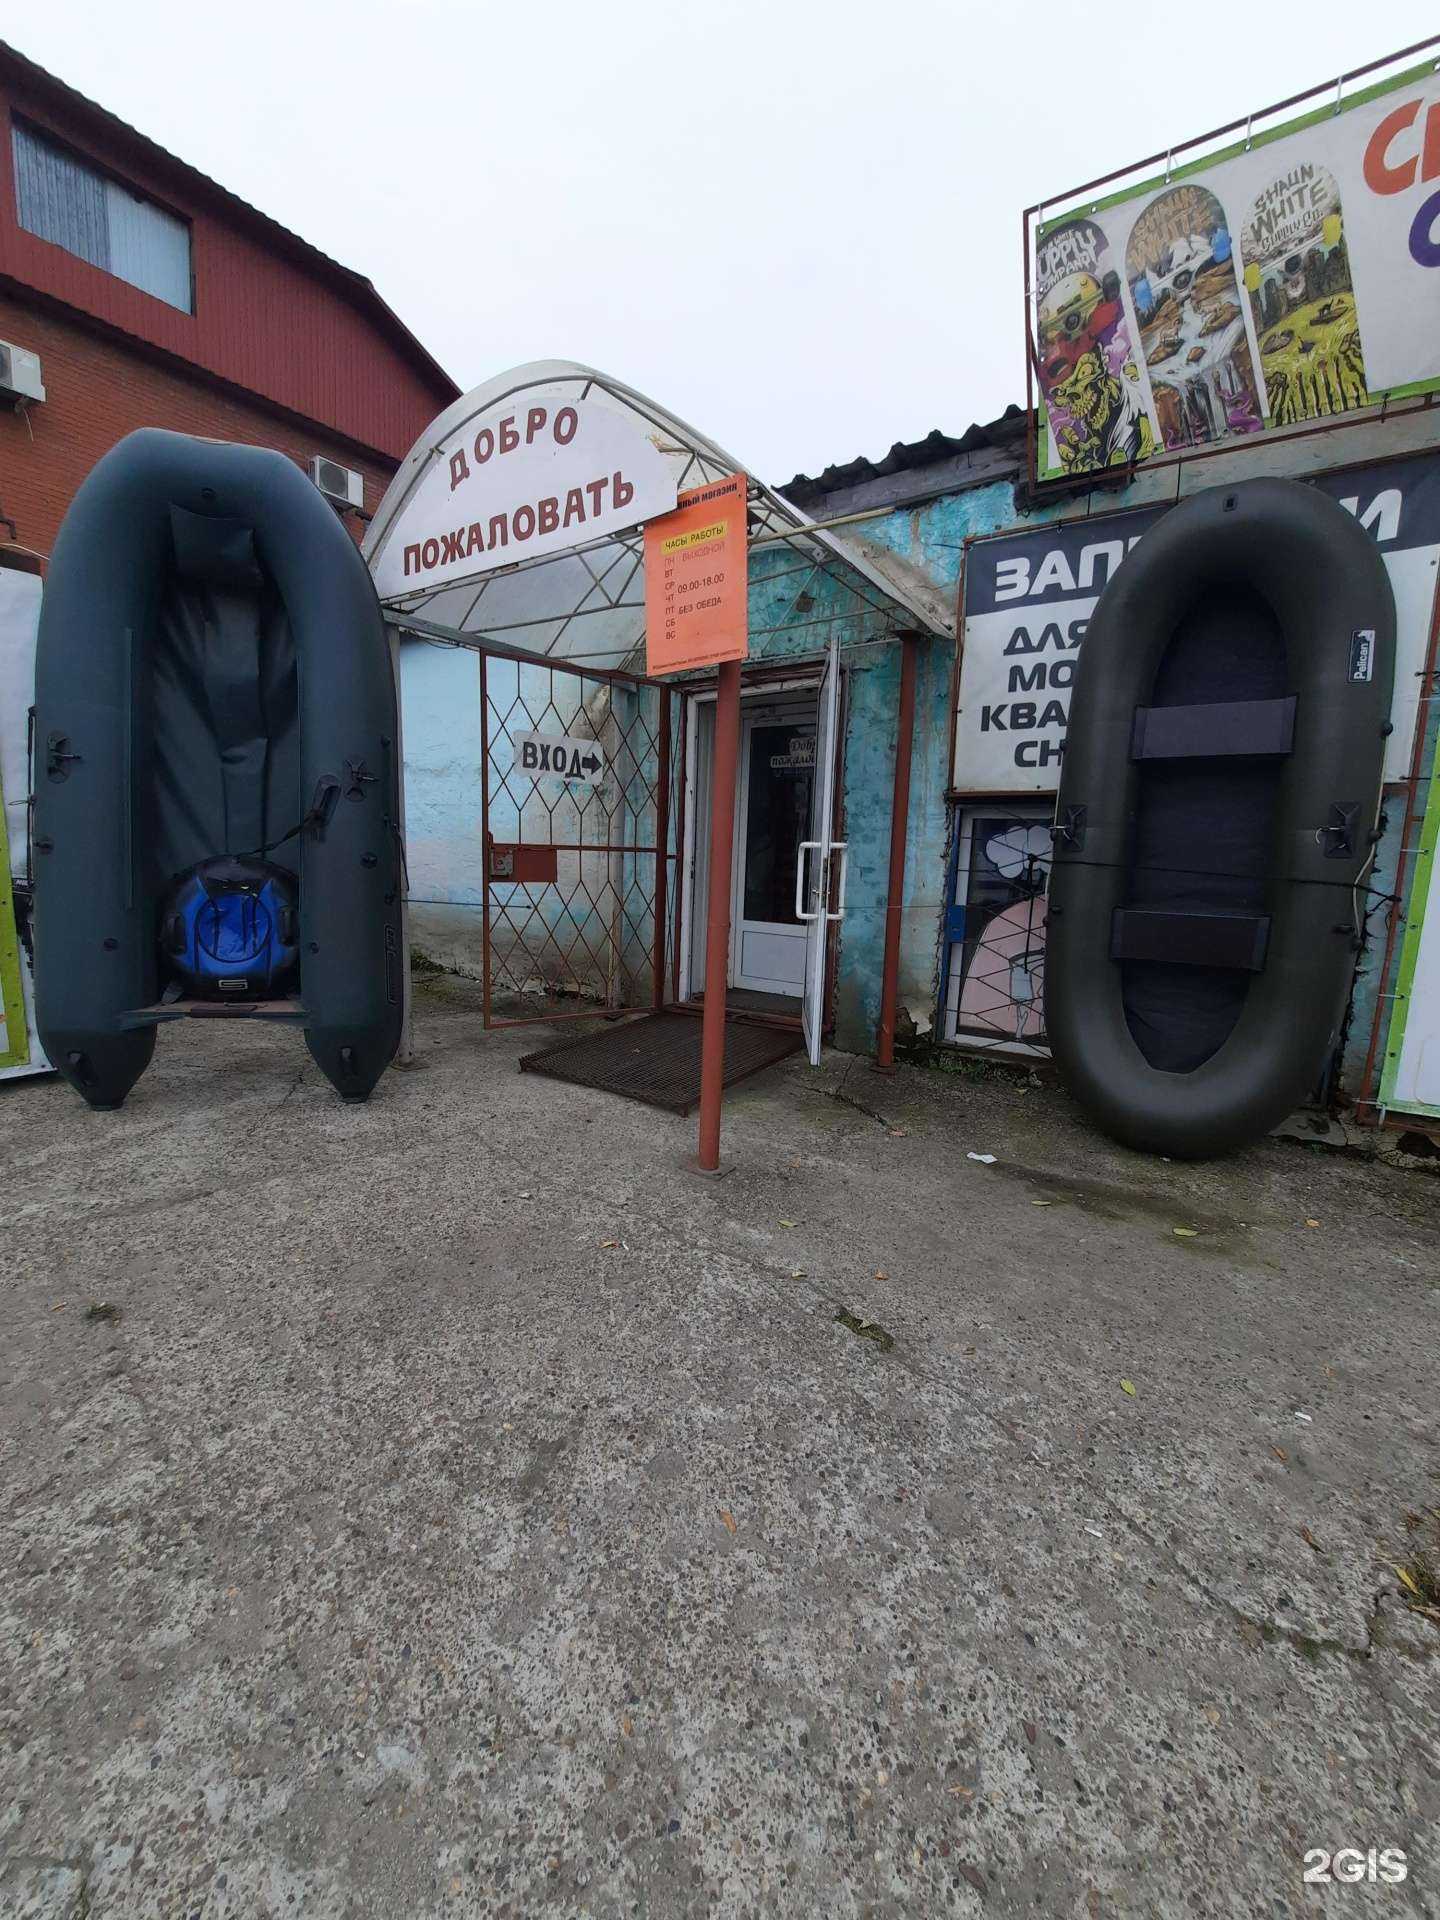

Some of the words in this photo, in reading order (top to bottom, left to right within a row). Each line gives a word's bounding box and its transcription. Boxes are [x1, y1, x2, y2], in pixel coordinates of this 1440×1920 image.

[1254, 164, 1314, 216] SHAUN
[1250, 178, 1328, 245] WHITE
[449, 407, 578, 492] ДОБРО
[404, 471, 634, 576] ПОЖАЛОВАТЬ
[665, 537, 688, 550] ЧАСЫ
[690, 526, 724, 544] РАБОТЫ
[678, 603, 693, 615] БЕЗ
[696, 595, 722, 610] ОБЕДА
[665, 618, 676, 628] СБ
[665, 631, 676, 640] ВС
[1008, 660, 1077, 692] МО
[1353, 642, 1369, 680] Pelican
[980, 700, 1070, 731] КВА
[522, 741, 585, 780] ВХОД
[1014, 740, 1065, 768] СН
